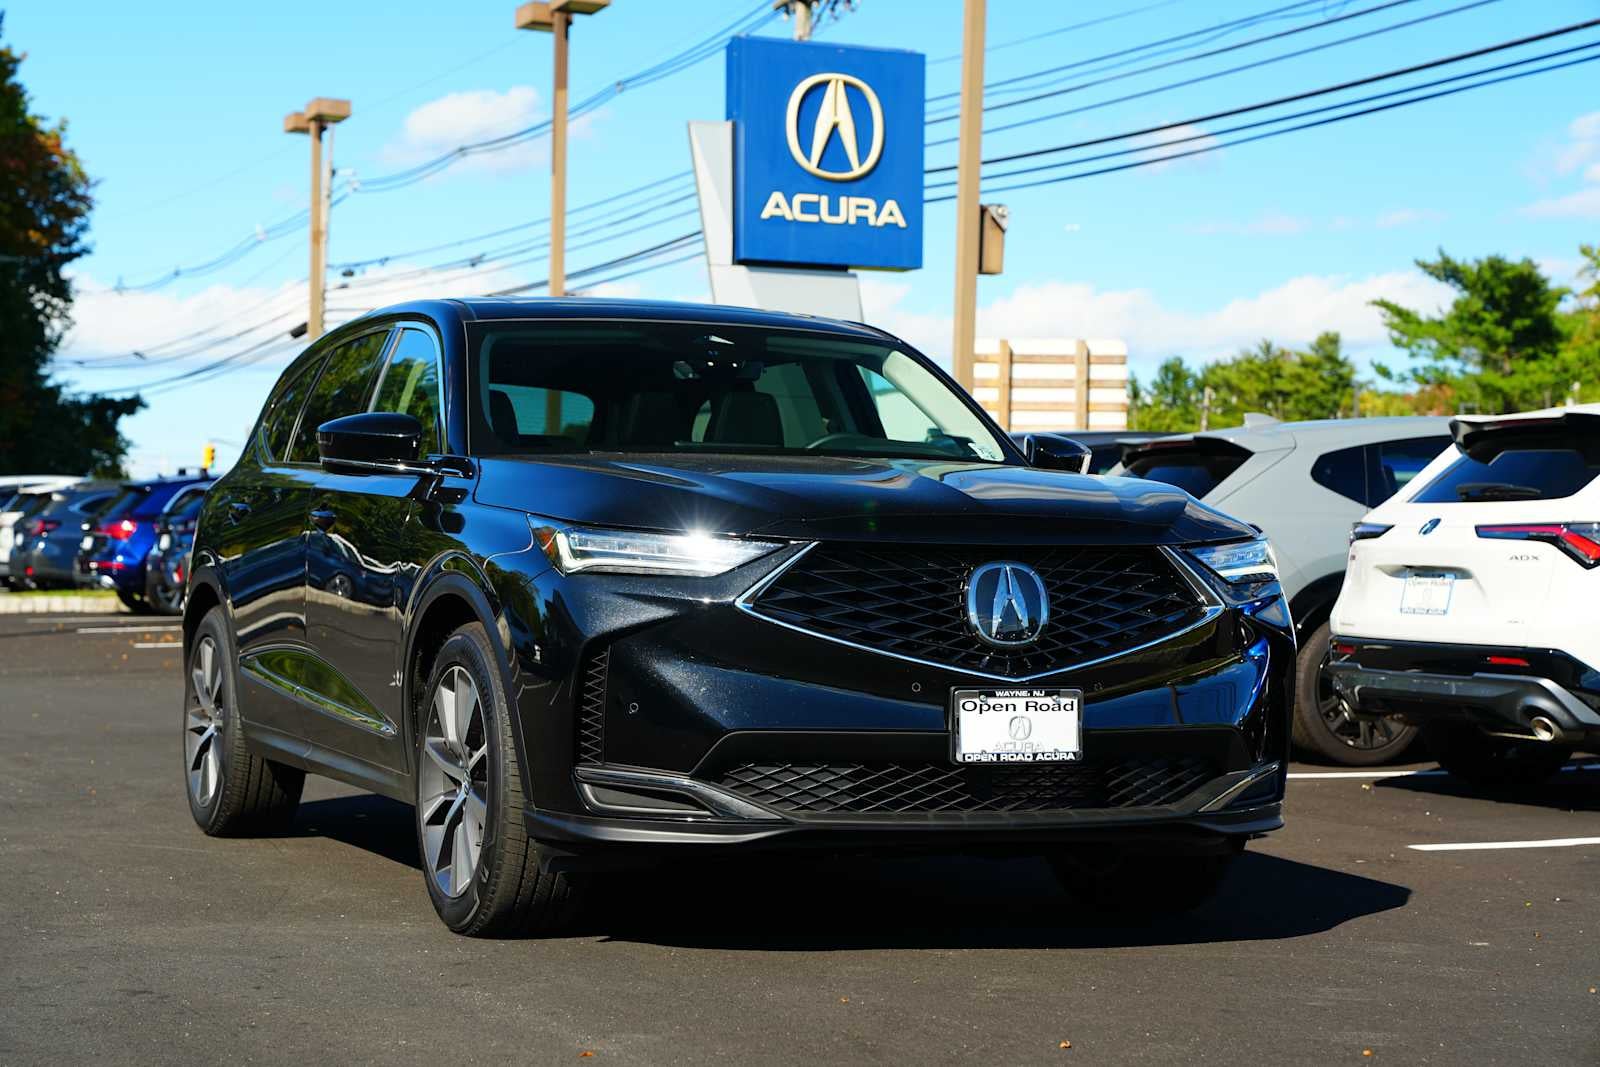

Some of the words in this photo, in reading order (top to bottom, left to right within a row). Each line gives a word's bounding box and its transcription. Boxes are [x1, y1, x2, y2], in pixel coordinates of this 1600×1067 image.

[760, 191, 907, 228] ACURA
[961, 701, 1017, 714] Open
[1025, 701, 1075, 712] Road
[965, 752, 998, 762] OPEN
[1000, 752, 1033, 761] ROAD
[1036, 752, 1076, 761] ACURA
